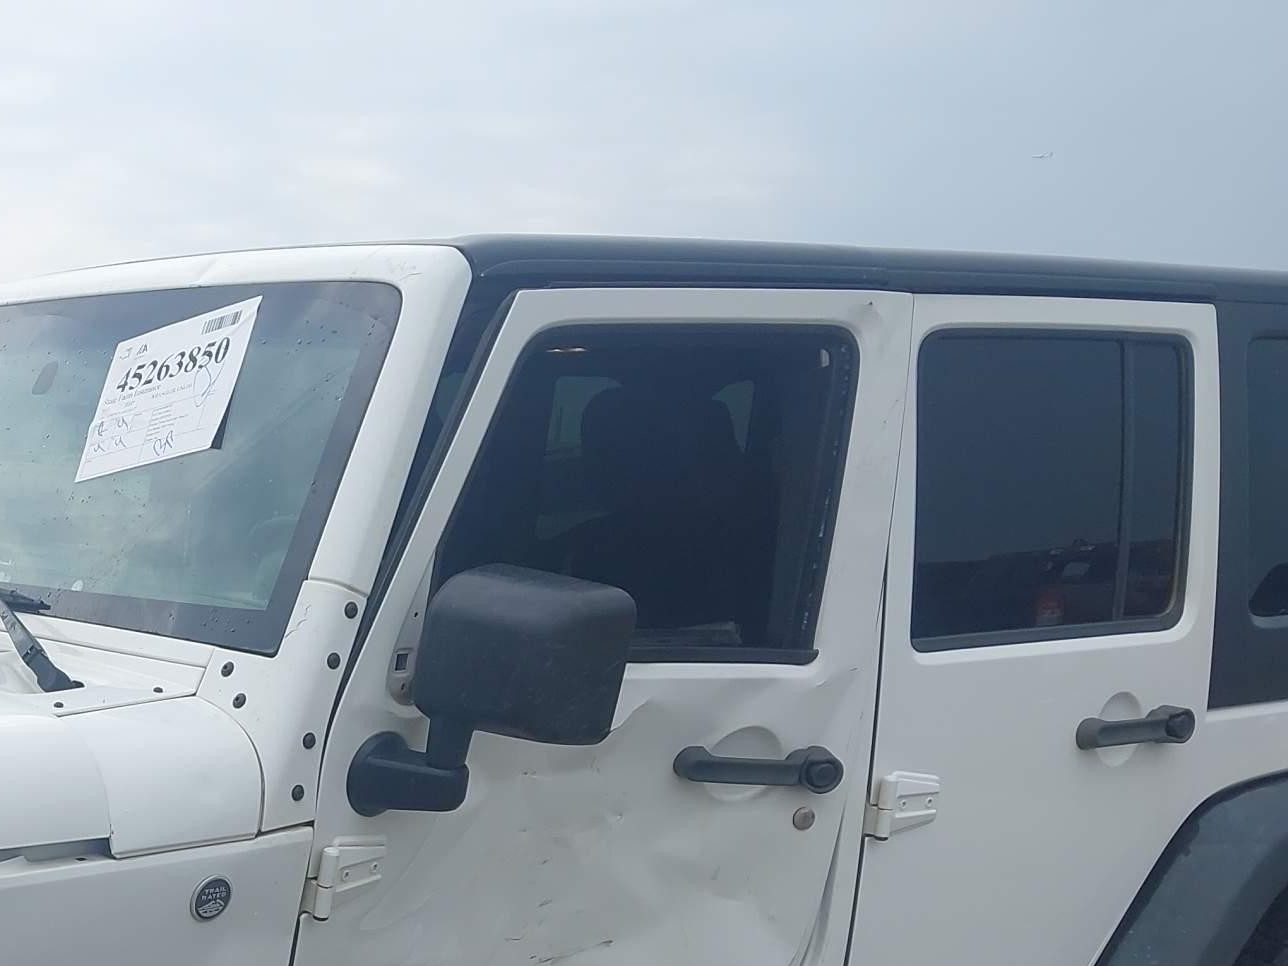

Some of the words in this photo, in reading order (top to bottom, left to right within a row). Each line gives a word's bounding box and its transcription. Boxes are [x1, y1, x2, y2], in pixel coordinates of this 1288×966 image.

[116, 336, 230, 393] 45263850
[204, 886, 227, 895] TRAIL
[201, 892, 227, 901] RATED
